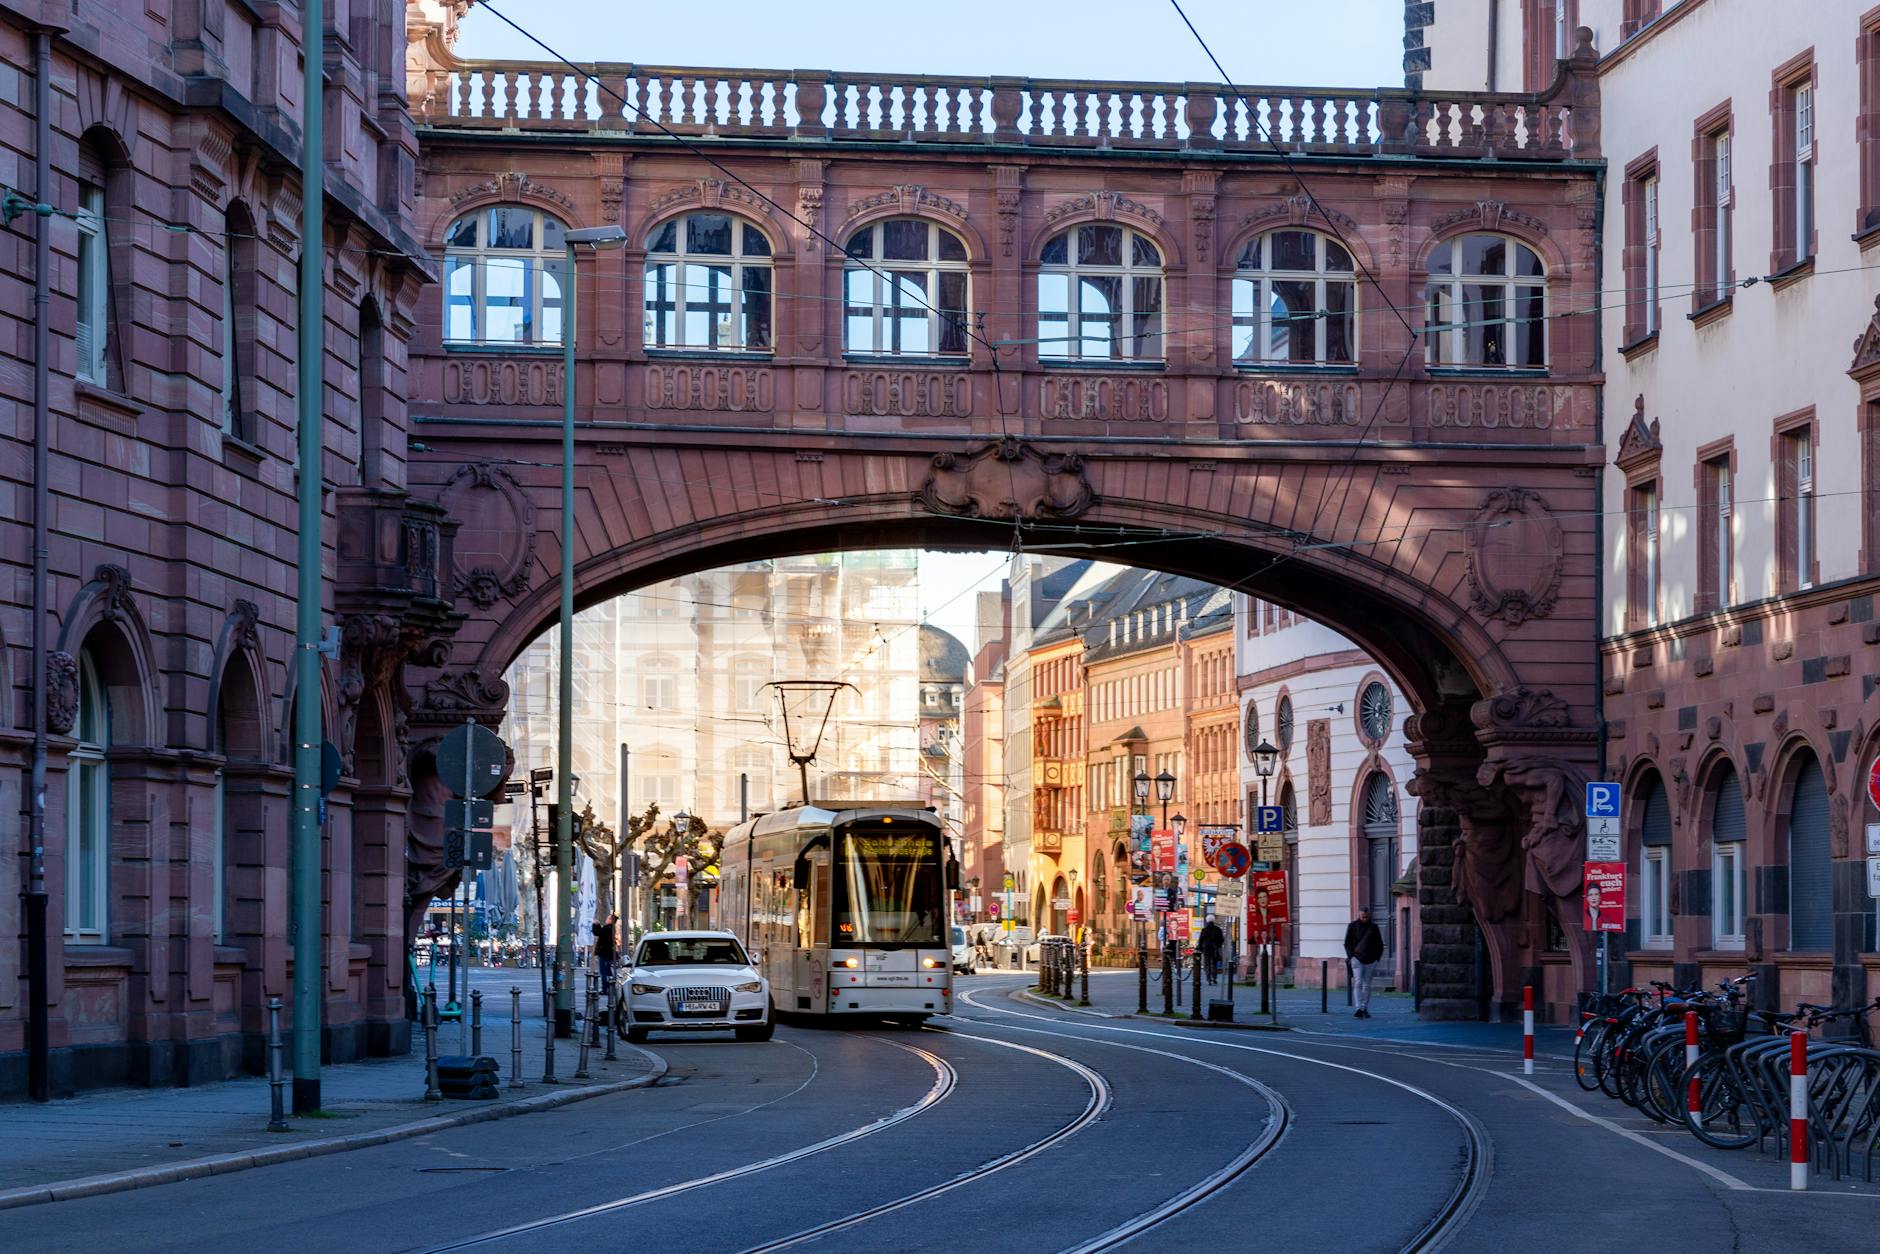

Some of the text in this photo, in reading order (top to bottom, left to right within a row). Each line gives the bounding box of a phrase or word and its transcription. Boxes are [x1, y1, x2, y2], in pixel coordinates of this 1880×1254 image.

[1592, 787, 1610, 813] P
[1263, 809, 1278, 829] P
[1600, 879, 1622, 887] euch
